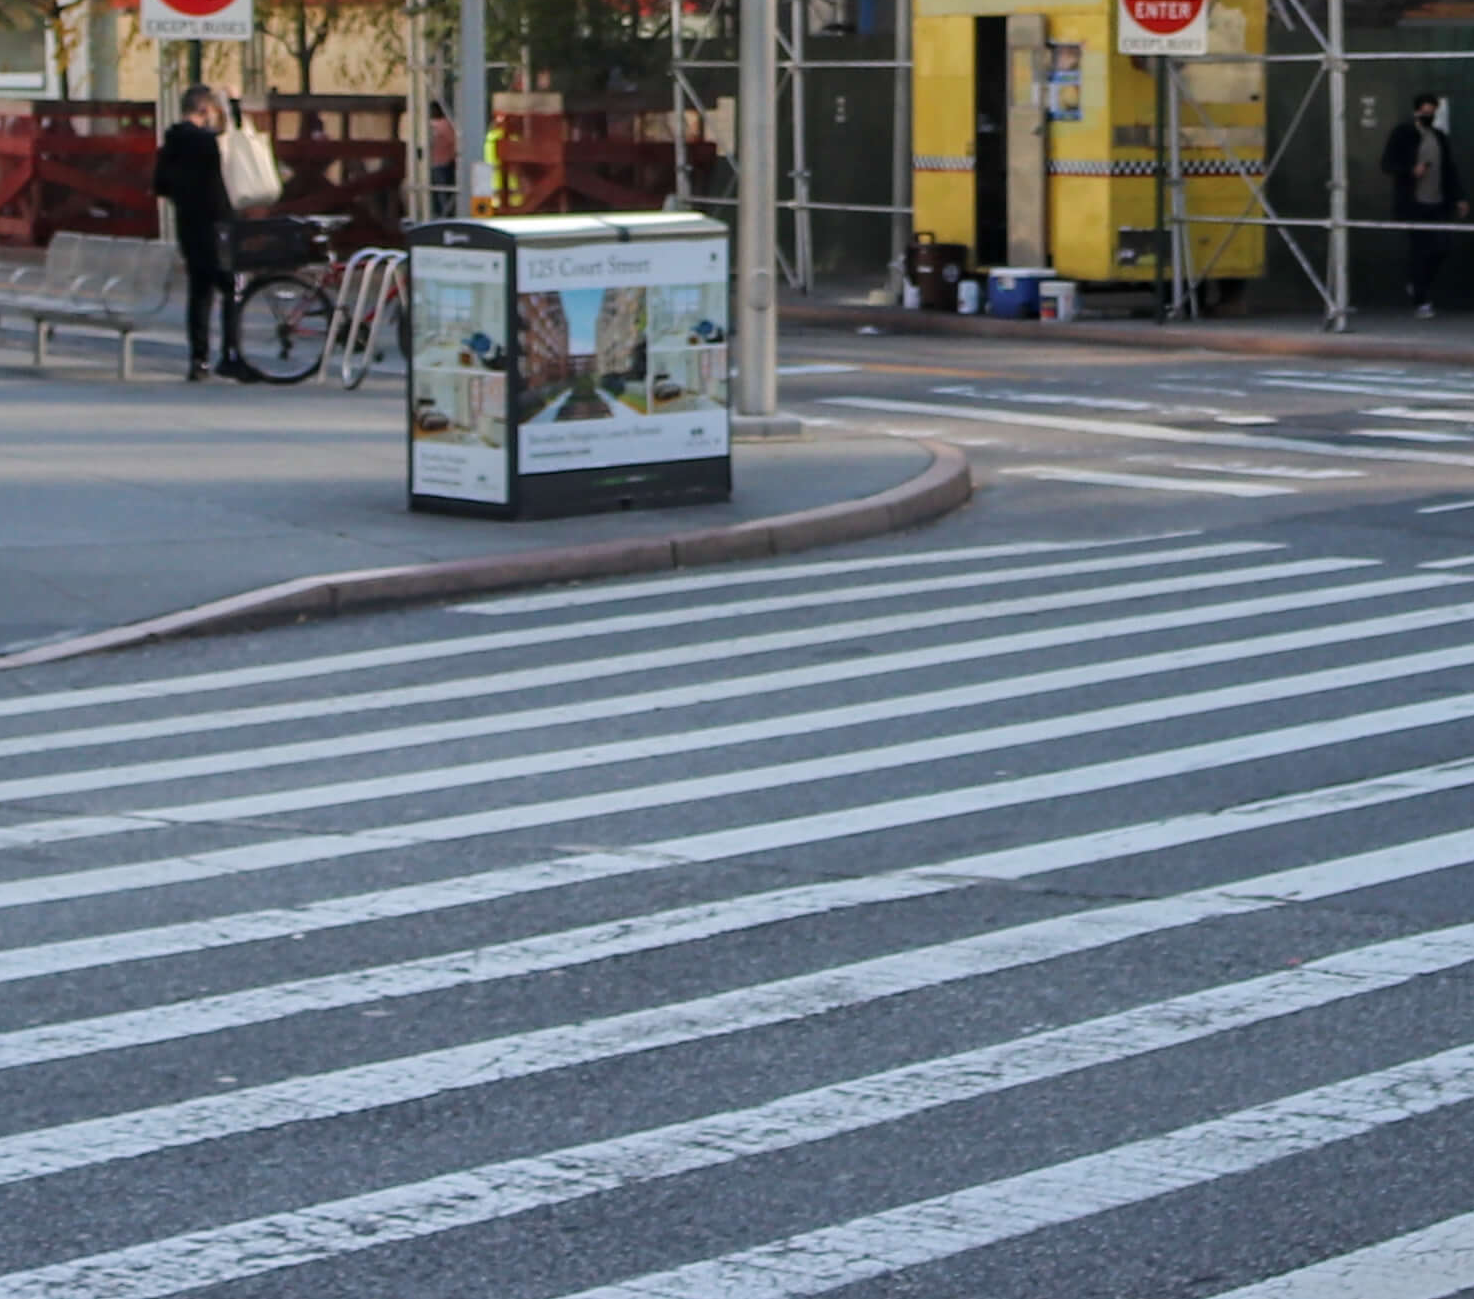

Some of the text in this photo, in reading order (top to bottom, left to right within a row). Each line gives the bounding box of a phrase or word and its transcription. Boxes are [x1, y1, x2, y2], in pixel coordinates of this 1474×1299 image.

[1134, 0, 1192, 20] ENTER
[558, 257, 602, 276] Court
[607, 255, 651, 274] Street
